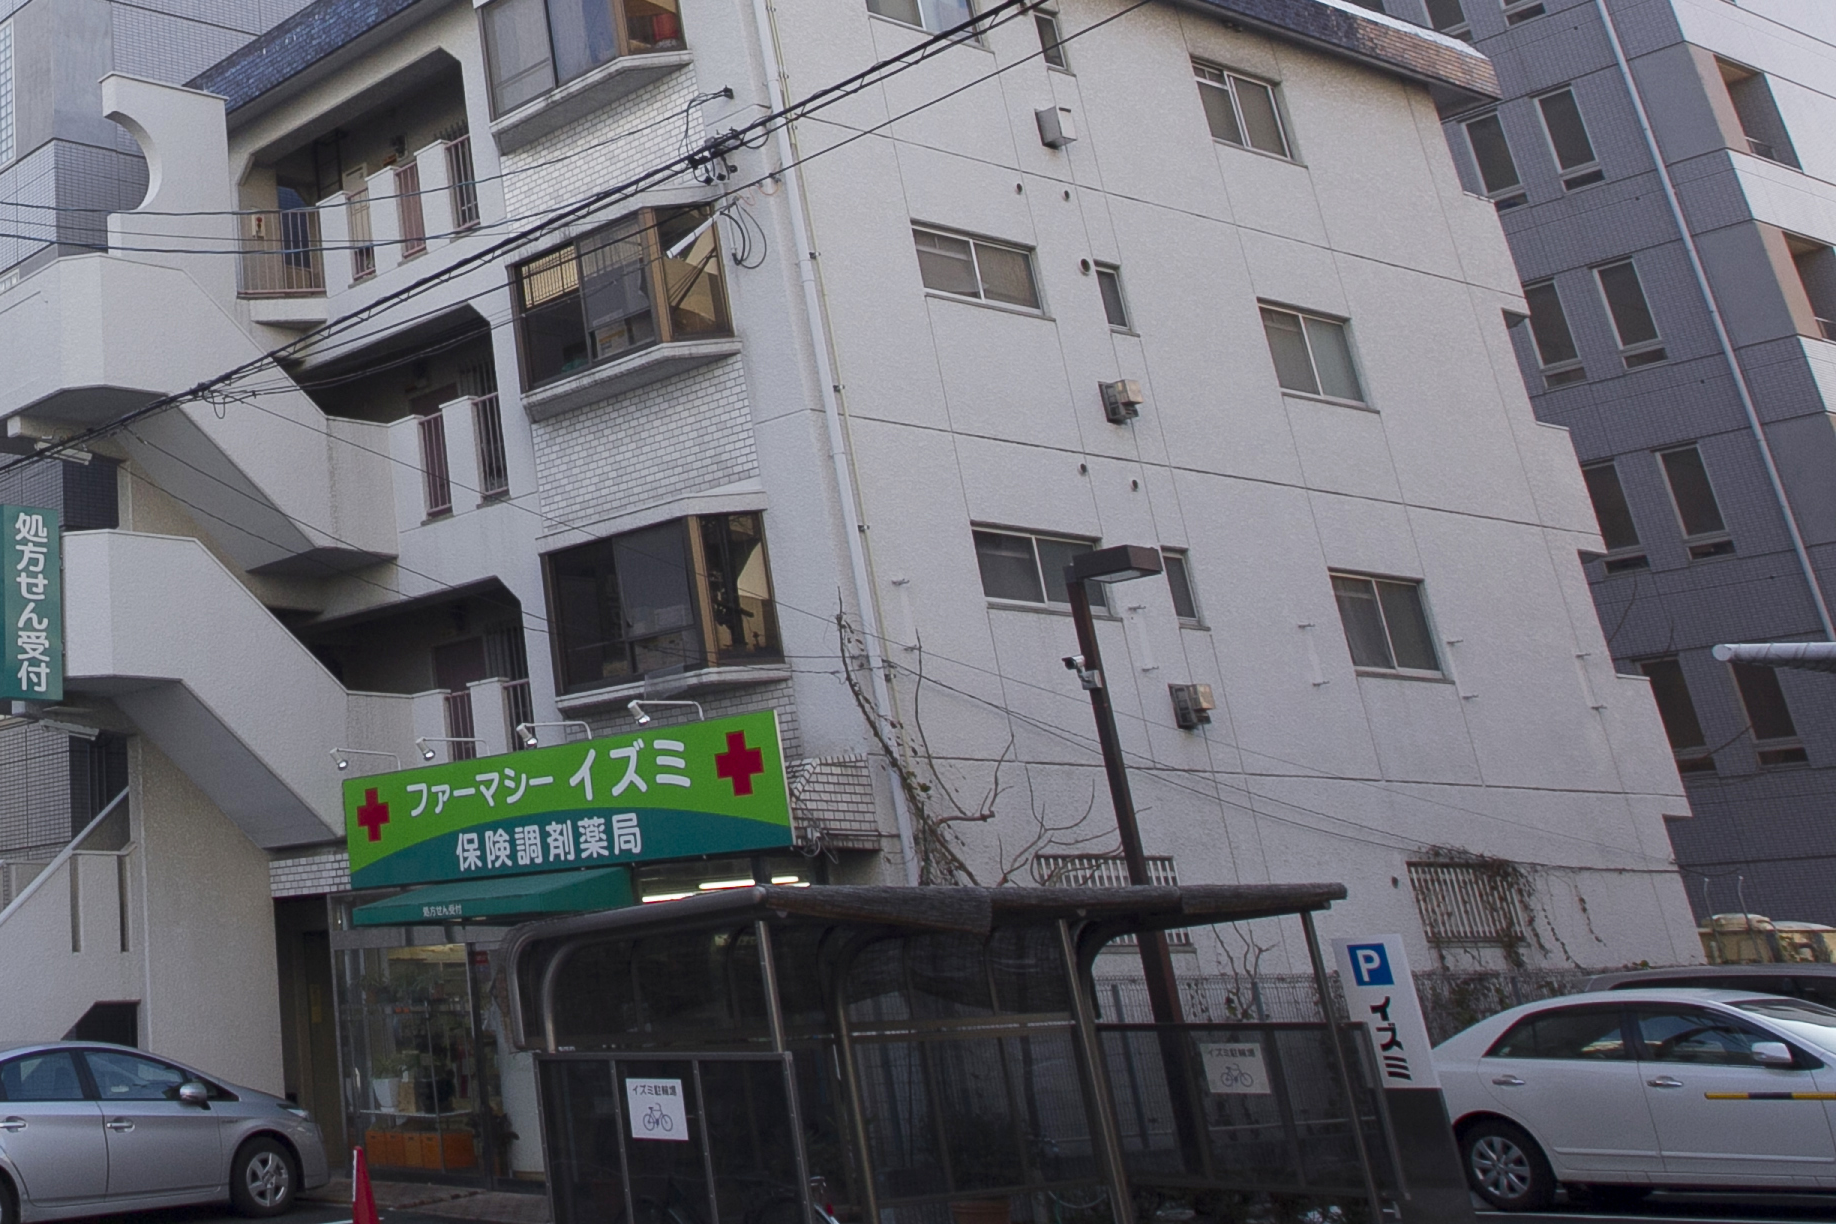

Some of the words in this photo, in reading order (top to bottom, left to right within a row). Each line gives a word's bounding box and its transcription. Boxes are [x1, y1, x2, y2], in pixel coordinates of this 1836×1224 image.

[13, 511, 50, 694] 処方せん受付
[455, 812, 643, 871] 保険調剤薬局
[422, 903, 462, 917] 処方せん受付
[1356, 949, 1382, 982] P
[1370, 995, 1412, 1081] イズミ
